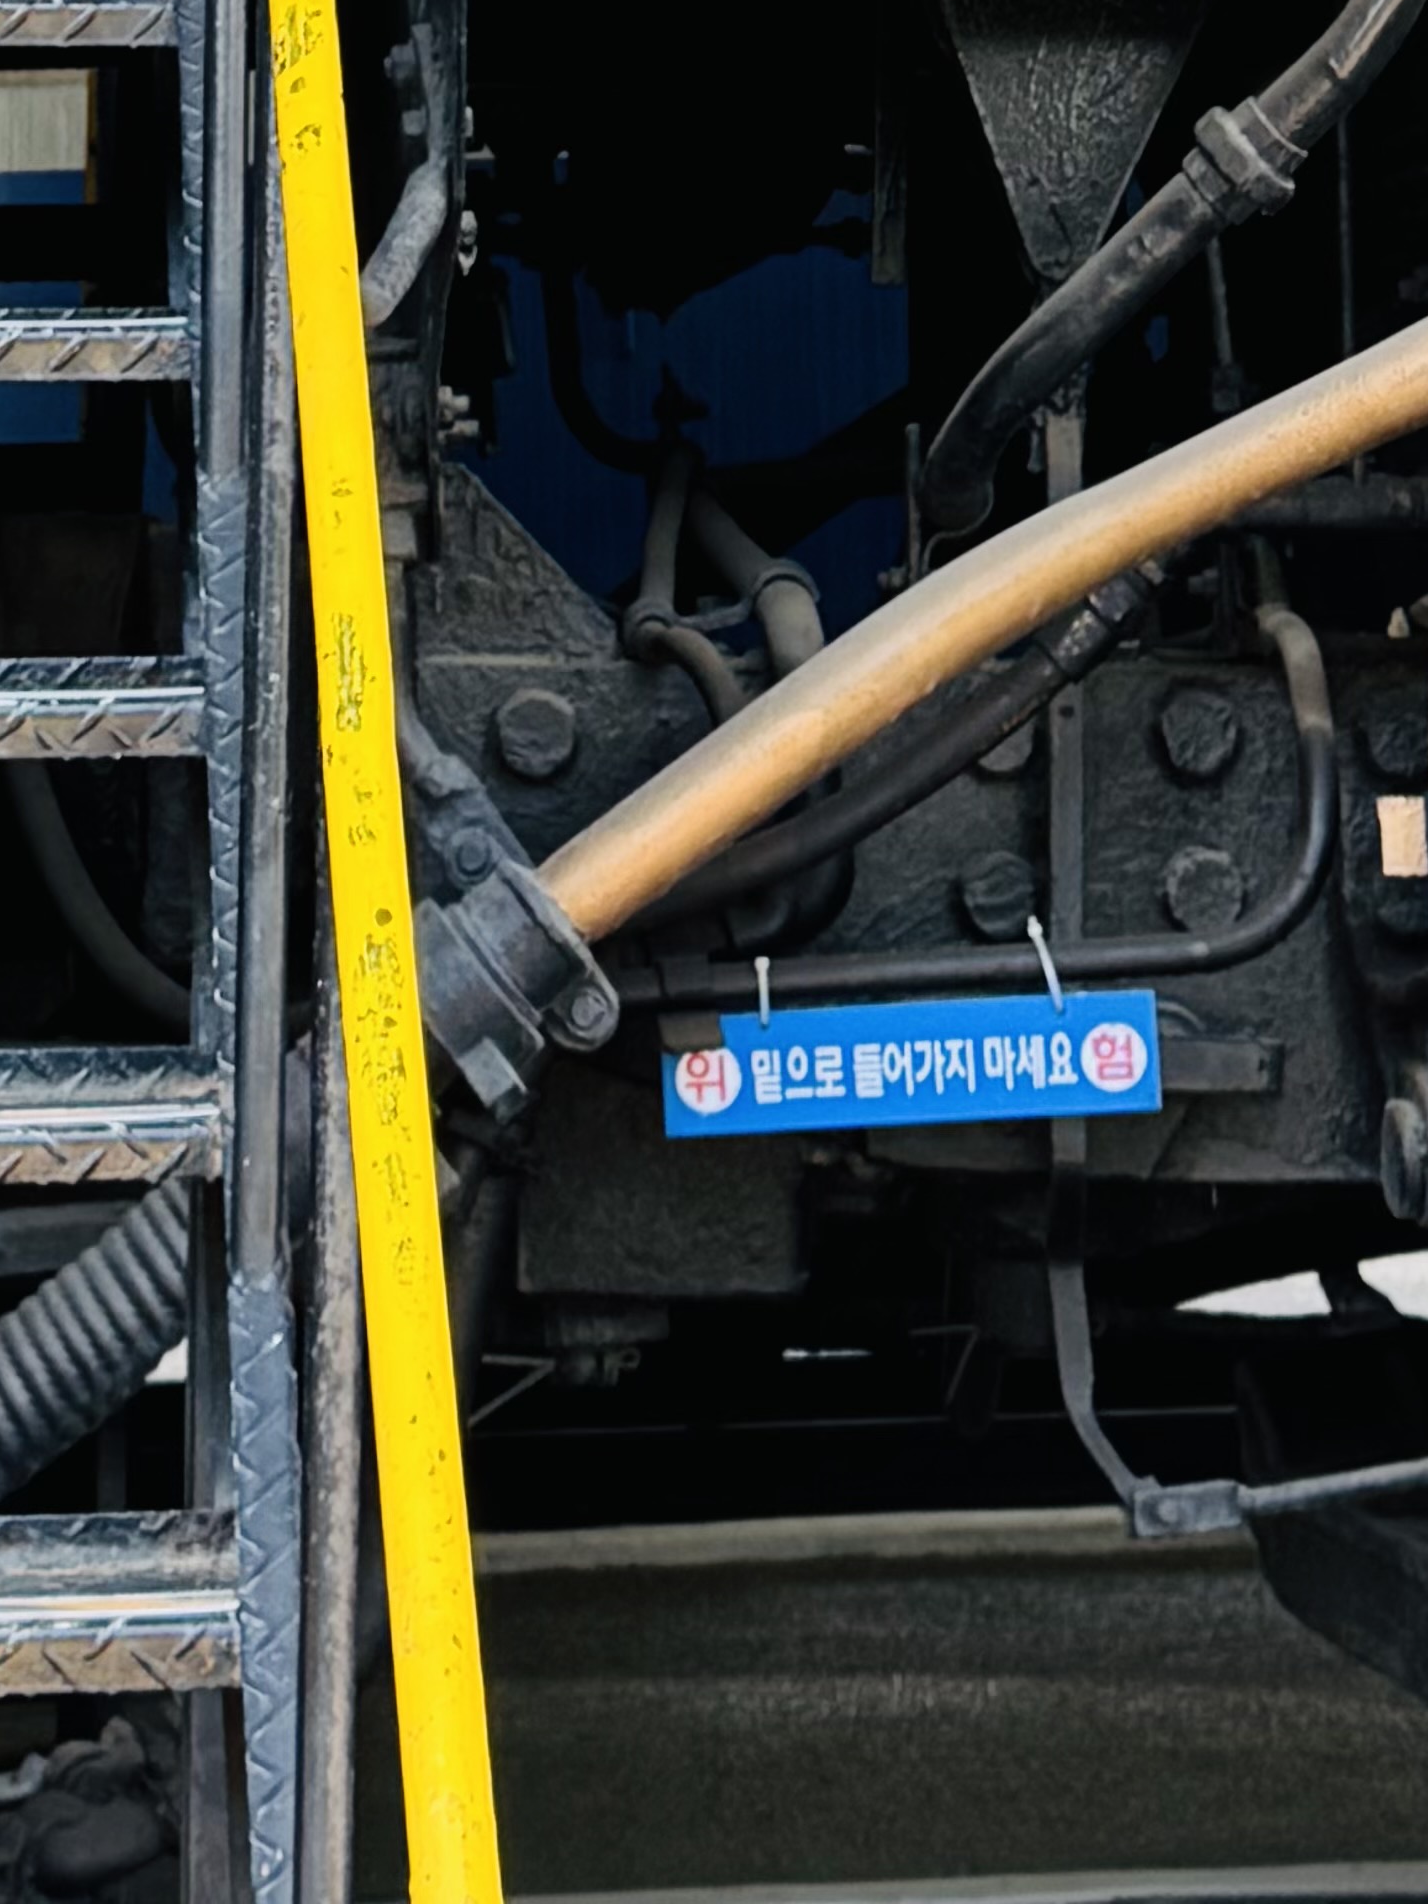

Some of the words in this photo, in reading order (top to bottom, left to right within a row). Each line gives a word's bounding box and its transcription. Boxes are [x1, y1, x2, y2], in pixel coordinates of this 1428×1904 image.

[685, 1050, 727, 1104] 위
[750, 1044, 847, 1106] 밑으로
[853, 1038, 975, 1099] 들어가지
[983, 1032, 1079, 1092] 마세요
[1093, 1032, 1134, 1082] 험
